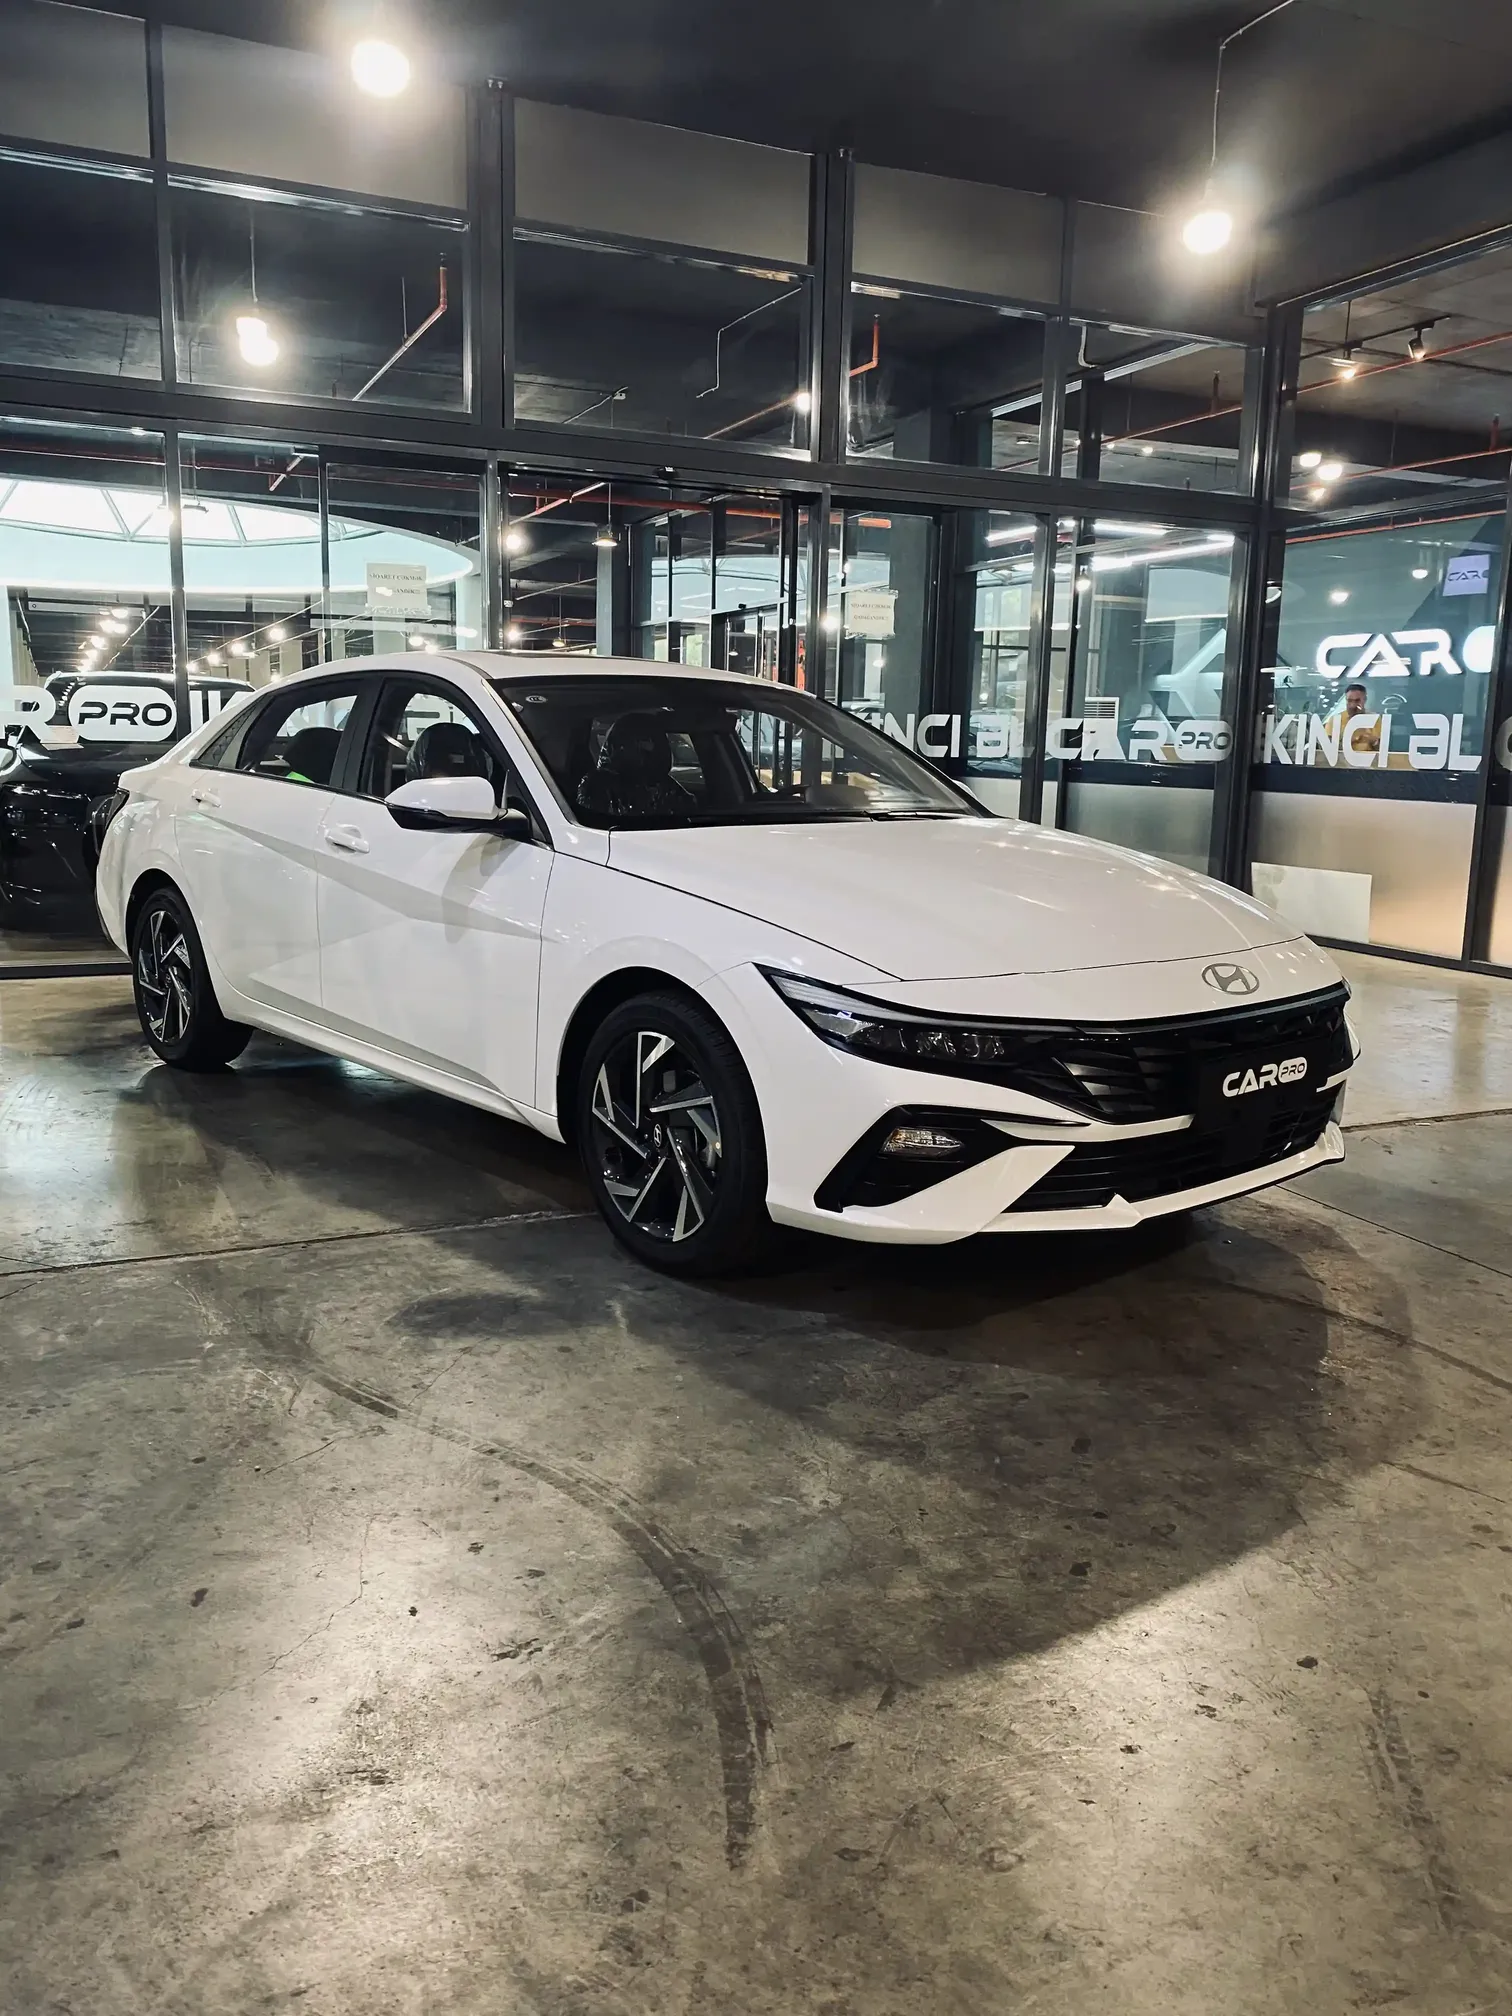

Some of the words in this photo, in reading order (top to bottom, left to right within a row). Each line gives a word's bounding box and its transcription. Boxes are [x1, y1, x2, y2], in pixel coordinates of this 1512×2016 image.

[1448, 570, 1481, 582] CAR
[1316, 628, 1463, 678] CAR
[1222, 1063, 1279, 1098] CAR
